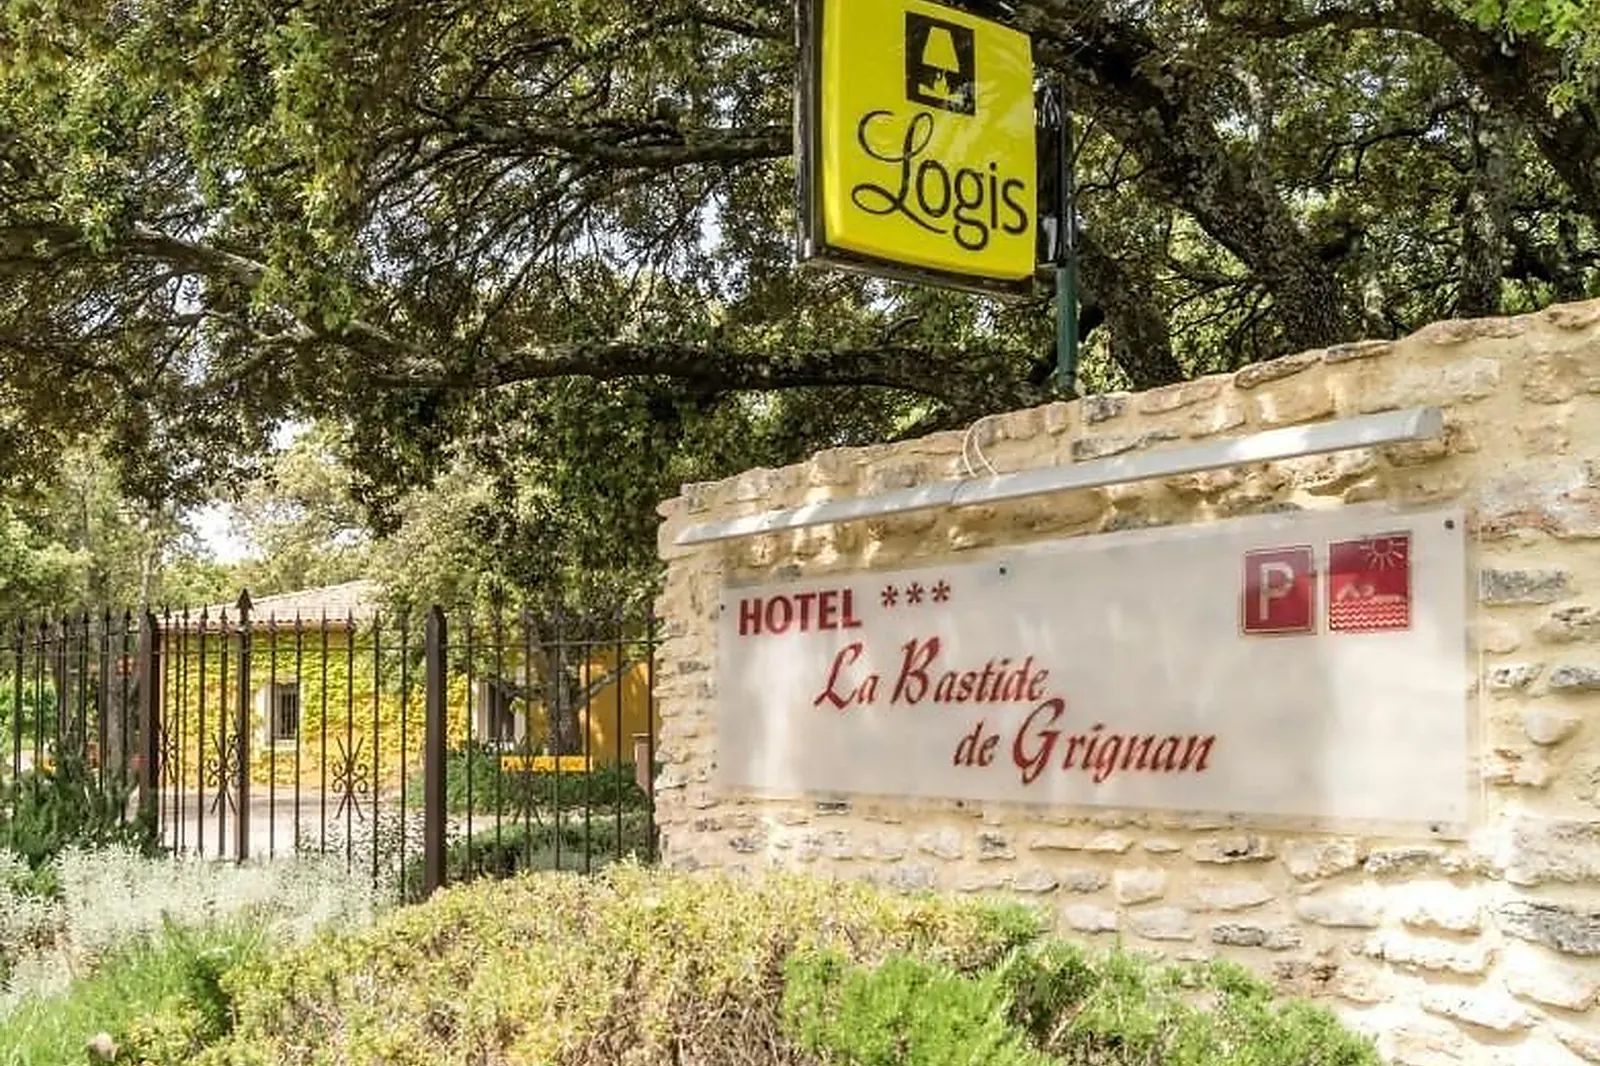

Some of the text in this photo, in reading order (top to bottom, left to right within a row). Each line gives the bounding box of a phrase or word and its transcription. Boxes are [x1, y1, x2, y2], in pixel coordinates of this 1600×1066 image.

[852, 110, 1028, 250] Logis
[739, 589, 862, 636] HOTEL
[1259, 562, 1294, 621] P
[813, 636, 1049, 709] La Bastide
[953, 698, 1216, 784] de Grignan
